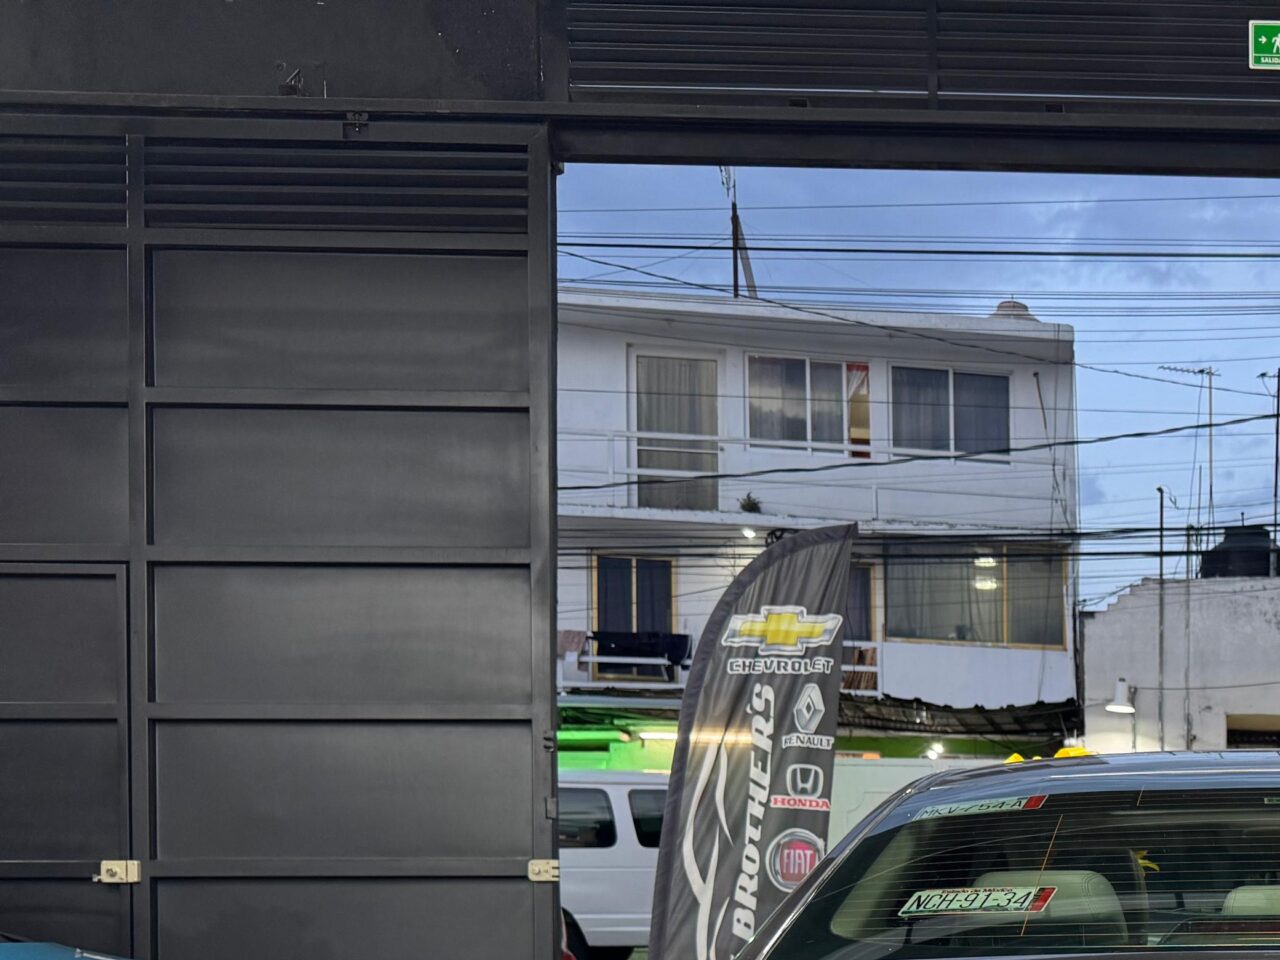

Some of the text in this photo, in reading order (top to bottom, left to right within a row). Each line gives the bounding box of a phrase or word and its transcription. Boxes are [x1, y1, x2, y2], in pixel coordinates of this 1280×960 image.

[727, 657, 834, 675] CHEVROLET
[782, 733, 835, 750] RENAULT
[771, 796, 831, 810] HONDA
[782, 848, 814, 874] FIAT
[907, 890, 1032, 911] NCH-91-34
